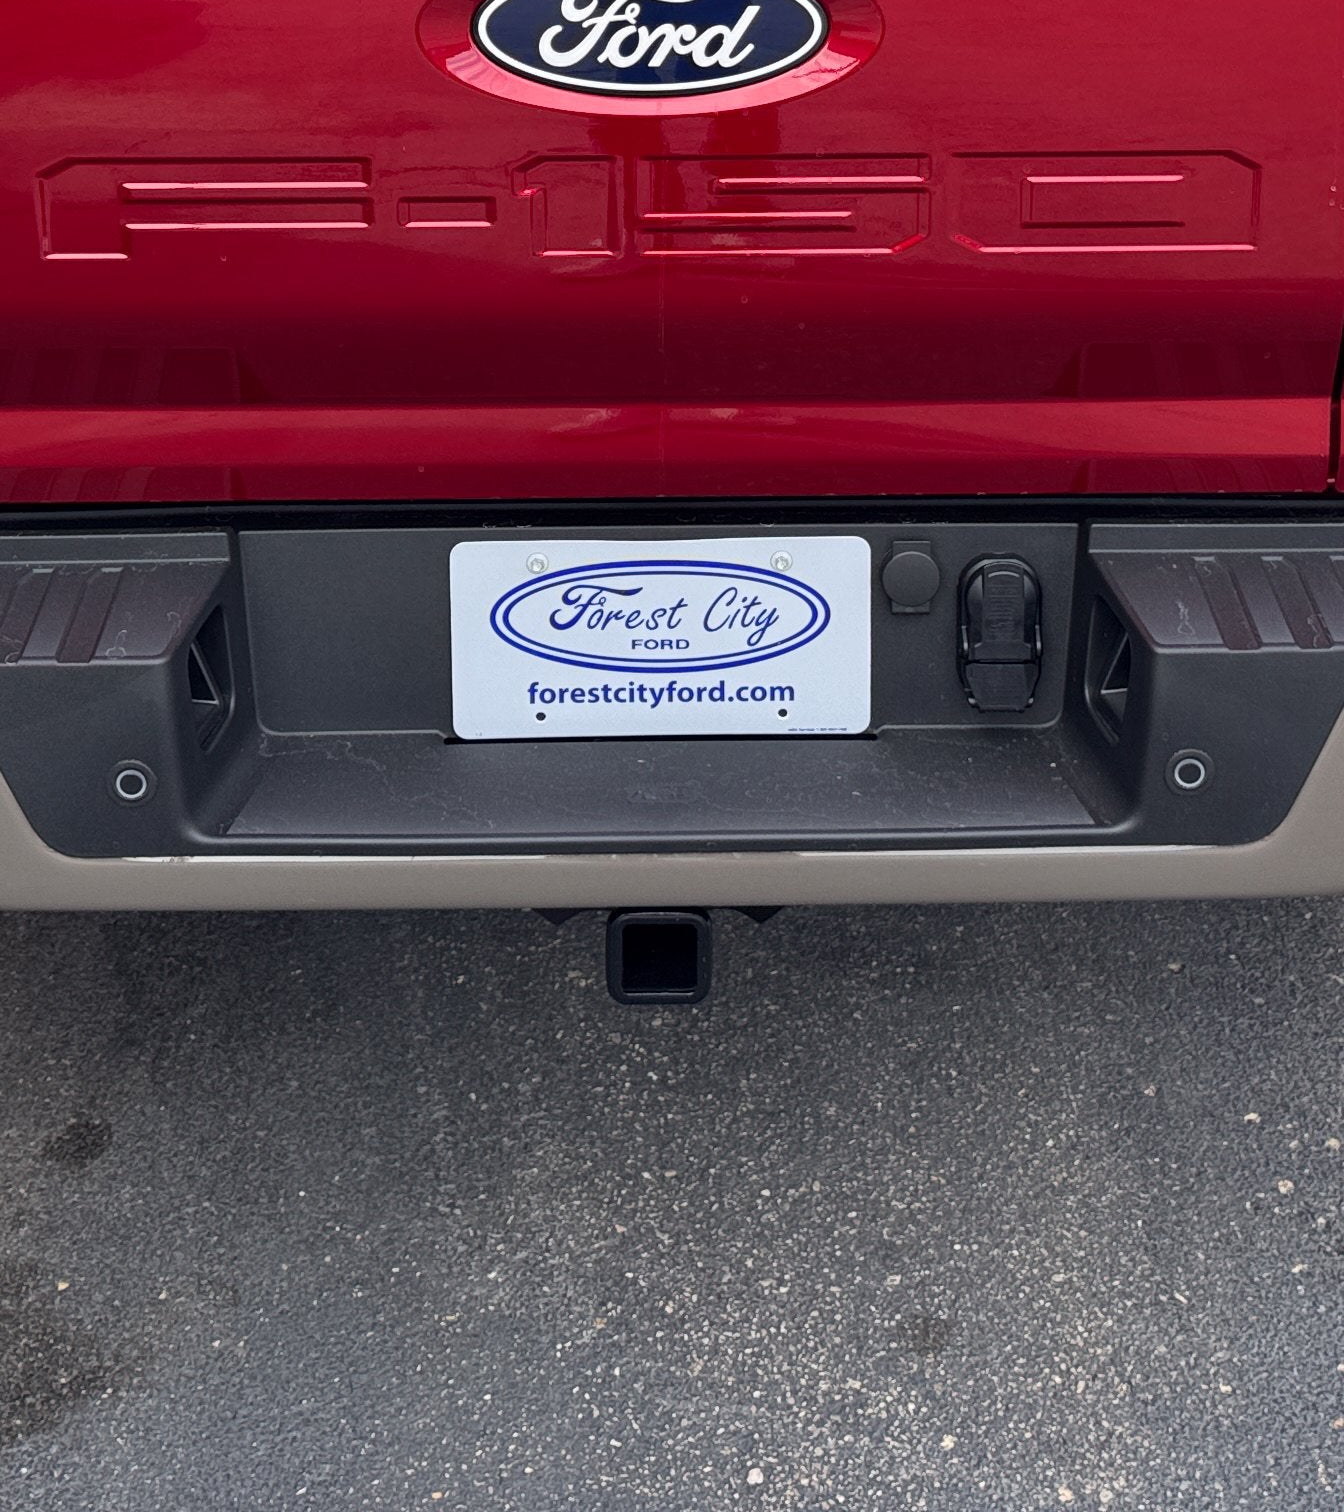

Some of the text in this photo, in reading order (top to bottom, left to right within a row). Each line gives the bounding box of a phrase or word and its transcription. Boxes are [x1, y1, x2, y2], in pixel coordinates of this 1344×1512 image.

[36, 149, 1262, 261] F-150
[549, 584, 779, 646] Forest City
[631, 639, 690, 650] FORD
[528, 681, 795, 708] forestcityford.com
